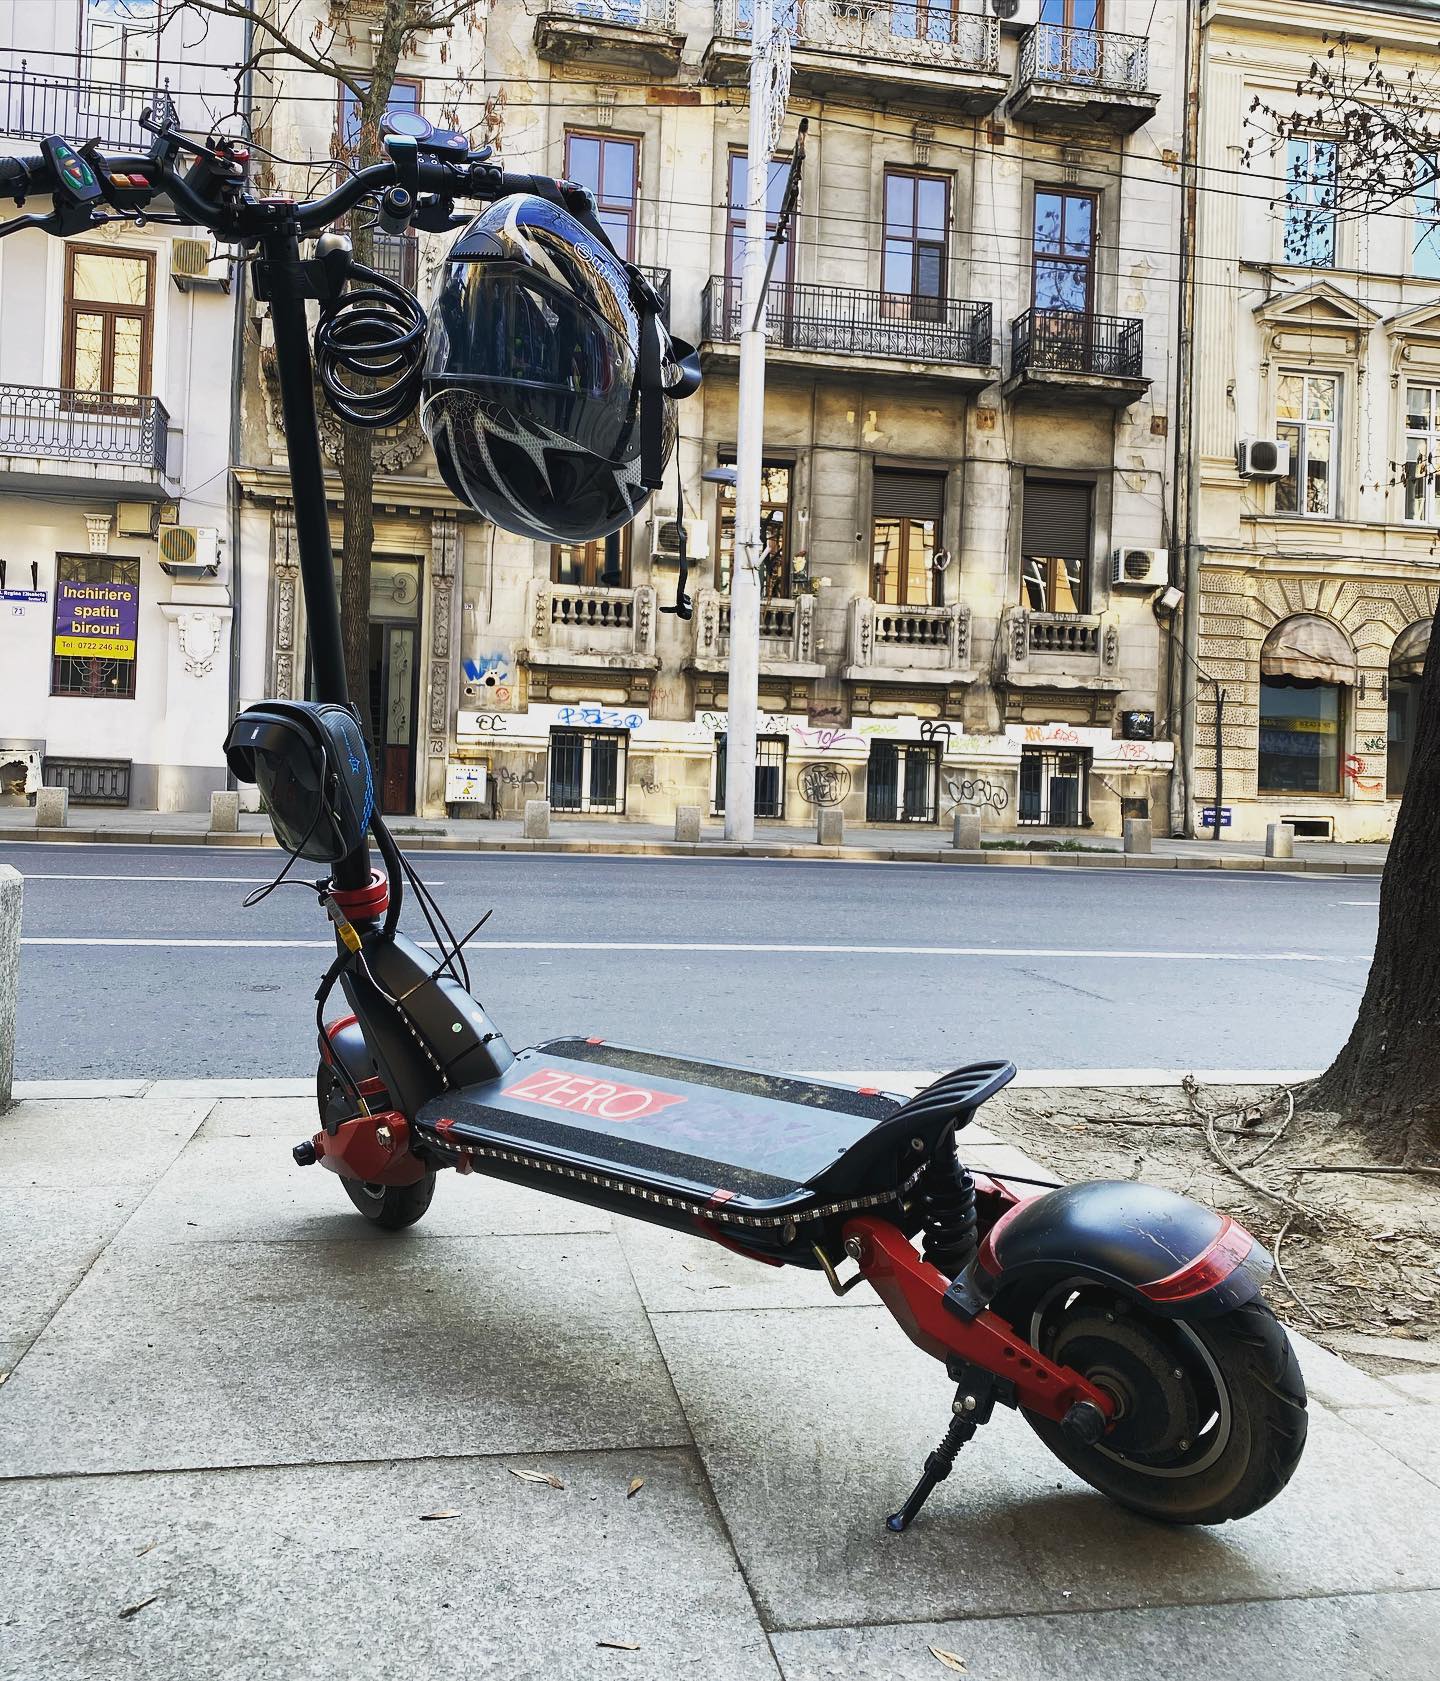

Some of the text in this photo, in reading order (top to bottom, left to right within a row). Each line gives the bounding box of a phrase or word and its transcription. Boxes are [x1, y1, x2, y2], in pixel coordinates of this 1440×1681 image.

[63, 585, 132, 601] Inchiriere
[14, 607, 23, 615] 71
[73, 605, 119, 619] spatiu
[71, 620, 120, 635] birouri
[78, 642, 97, 650] 0722
[98, 643, 113, 651] 246
[115, 644, 129, 652] 403
[430, 740, 443, 753] 73
[510, 1071, 653, 1118] ZERO
